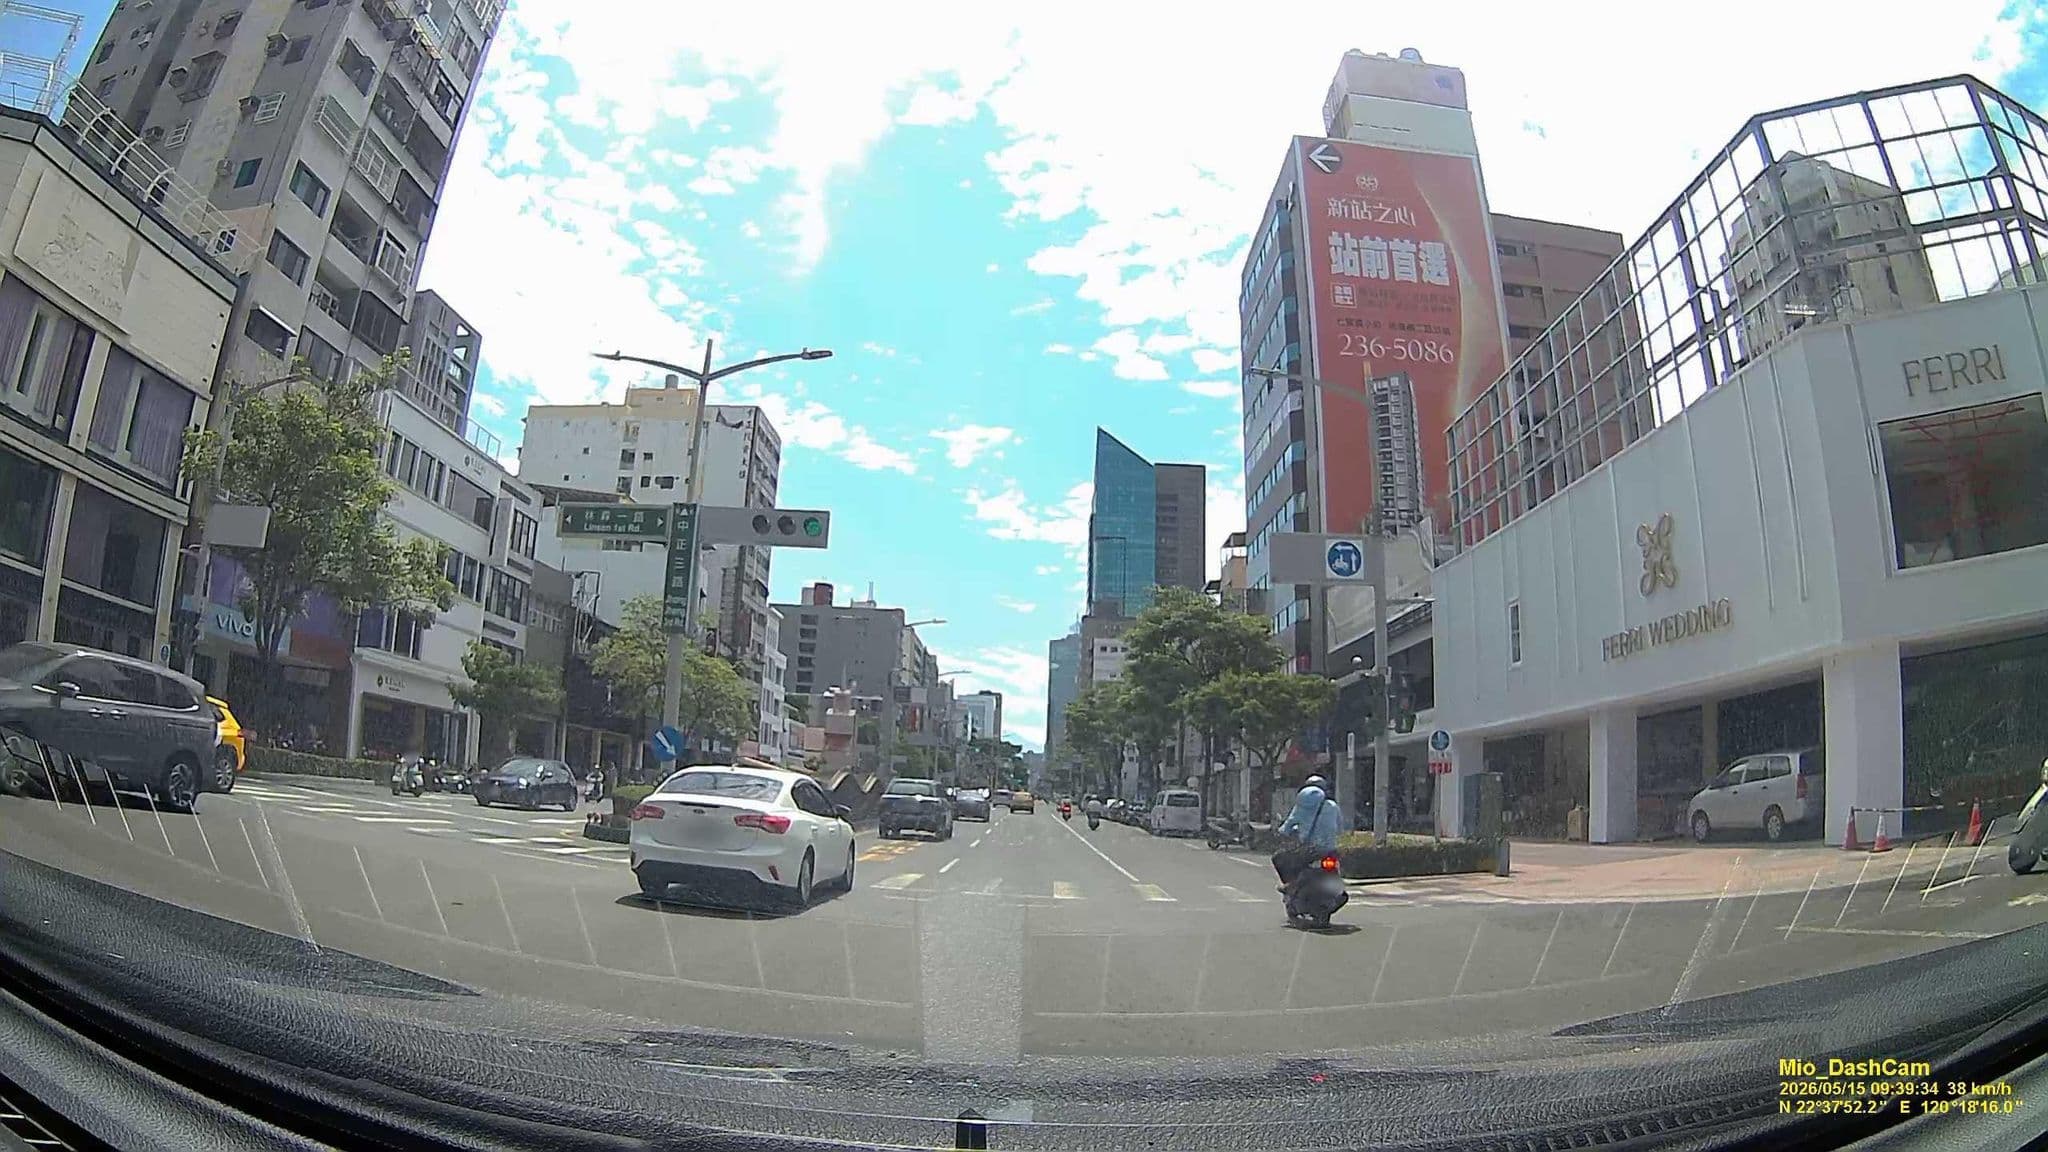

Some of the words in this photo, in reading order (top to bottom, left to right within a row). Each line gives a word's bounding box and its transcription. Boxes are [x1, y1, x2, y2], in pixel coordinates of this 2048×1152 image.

[1328, 198, 1416, 227] 新站之心
[1329, 231, 1450, 286] 站前首選
[1338, 333, 1454, 364] 236-5086
[1902, 344, 2006, 397] FERRI
[671, 520, 689, 588] 中正三路
[216, 613, 254, 637] vivo
[1602, 626, 1643, 661] FERRI
[1648, 597, 1731, 647] WEDDING
